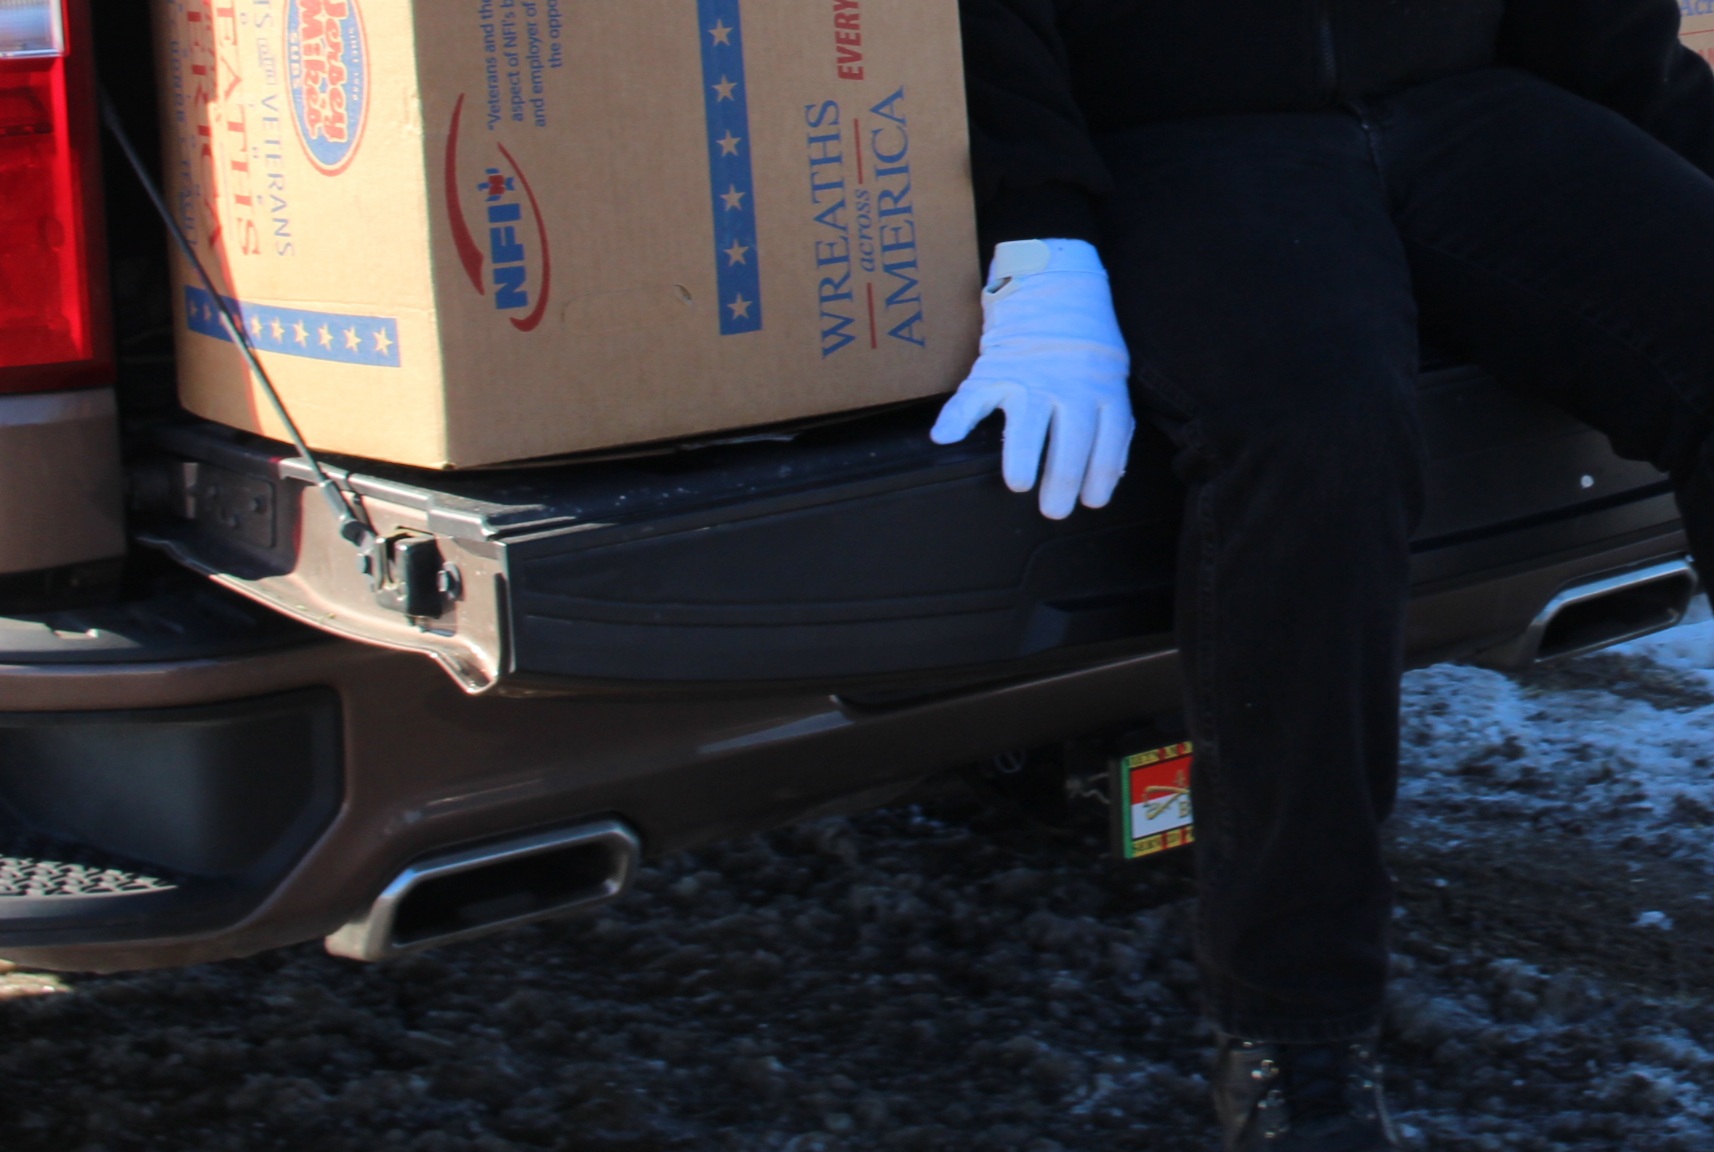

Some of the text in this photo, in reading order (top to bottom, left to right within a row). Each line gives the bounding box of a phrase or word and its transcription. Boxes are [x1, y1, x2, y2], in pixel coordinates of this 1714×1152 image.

[502, 10, 517, 48] NFI's
[520, 1, 538, 18] of
[479, 23, 496, 53] and
[503, 51, 519, 67] of
[525, 22, 545, 95] employer
[547, 42, 563, 69] the
[507, 71, 526, 122] aspect
[529, 98, 546, 127] and
[261, 92, 295, 258] VETERANS
[805, 99, 856, 361] WREATHS
[855, 188, 875, 273] across
[868, 84, 927, 348] AMERICA
[487, 202, 529, 310] NFI
